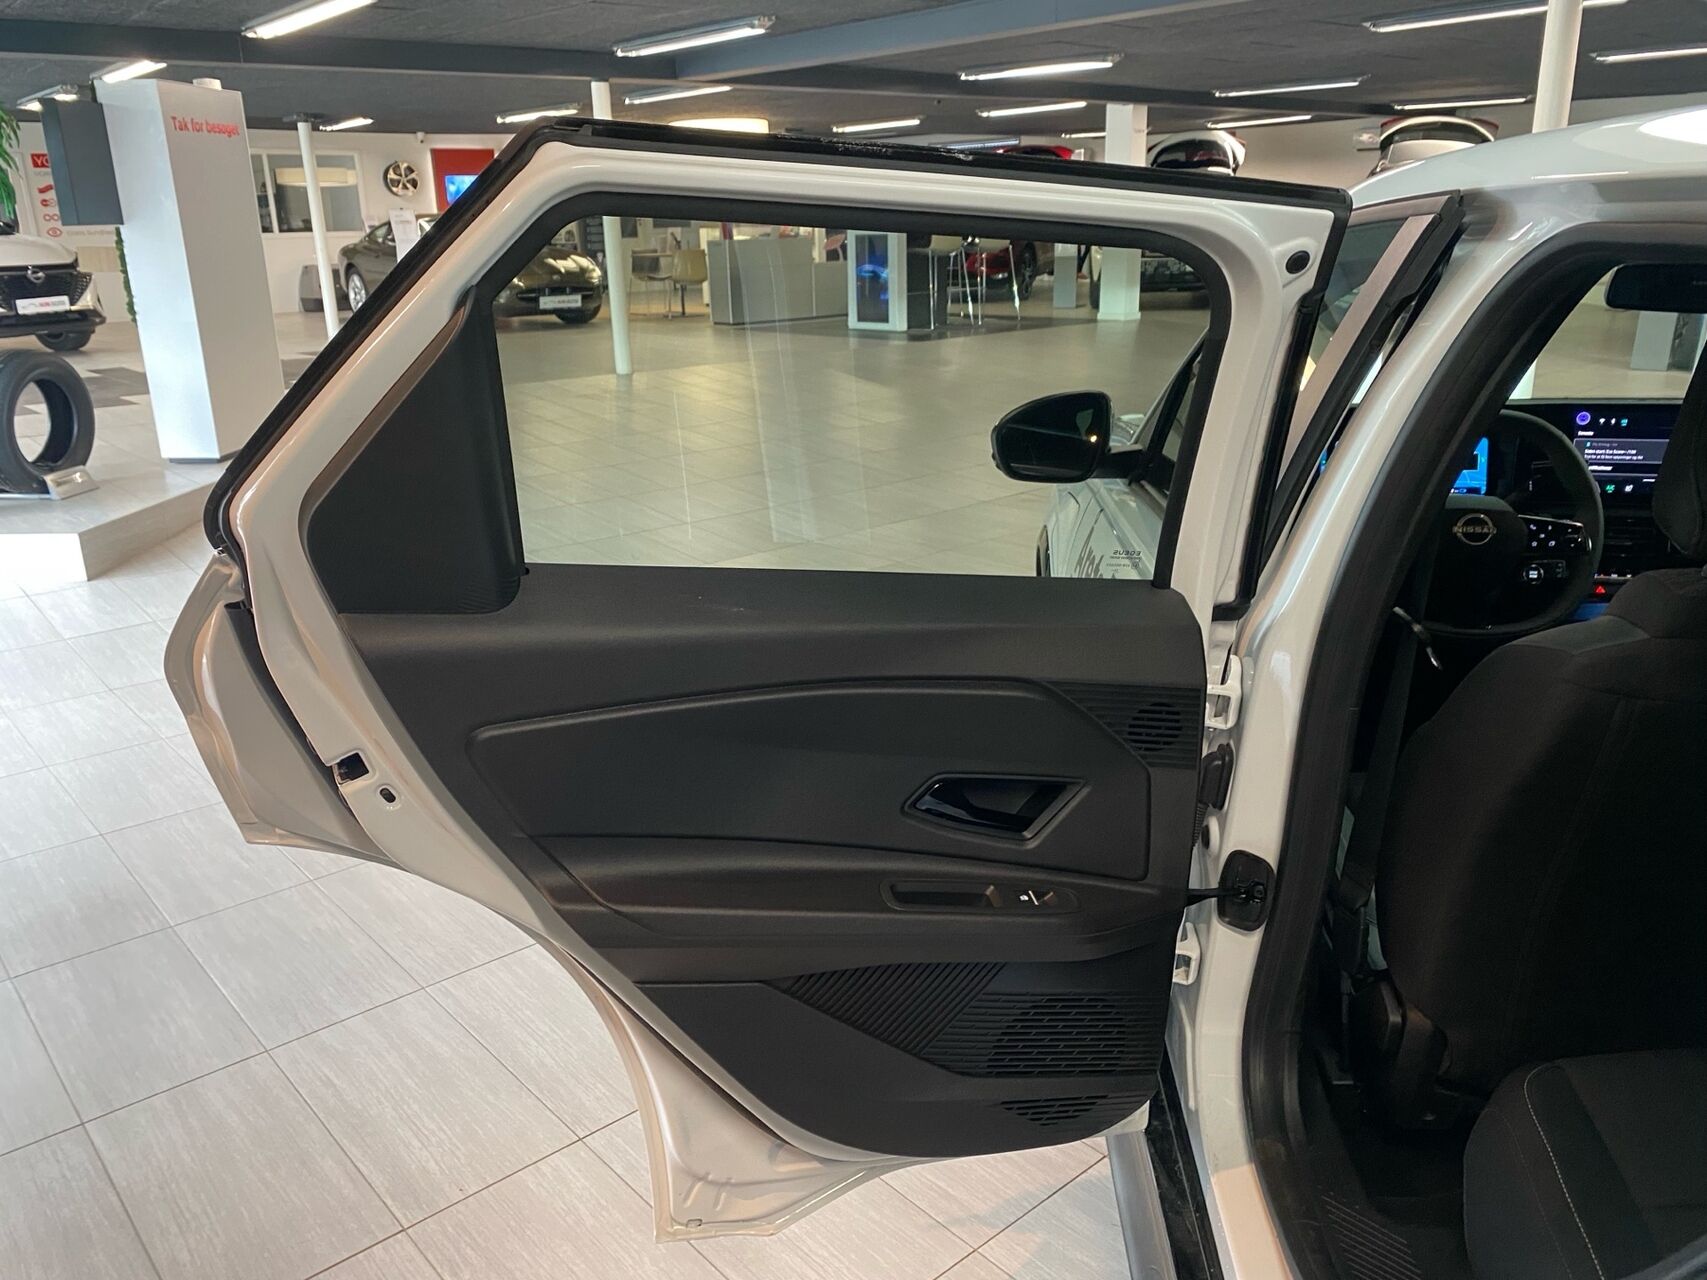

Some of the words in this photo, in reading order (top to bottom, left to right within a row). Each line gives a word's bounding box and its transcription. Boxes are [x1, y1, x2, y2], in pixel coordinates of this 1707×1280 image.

[171, 116, 190, 131] Tak
[191, 117, 204, 133] for
[1452, 525, 1497, 534] NISSAN
